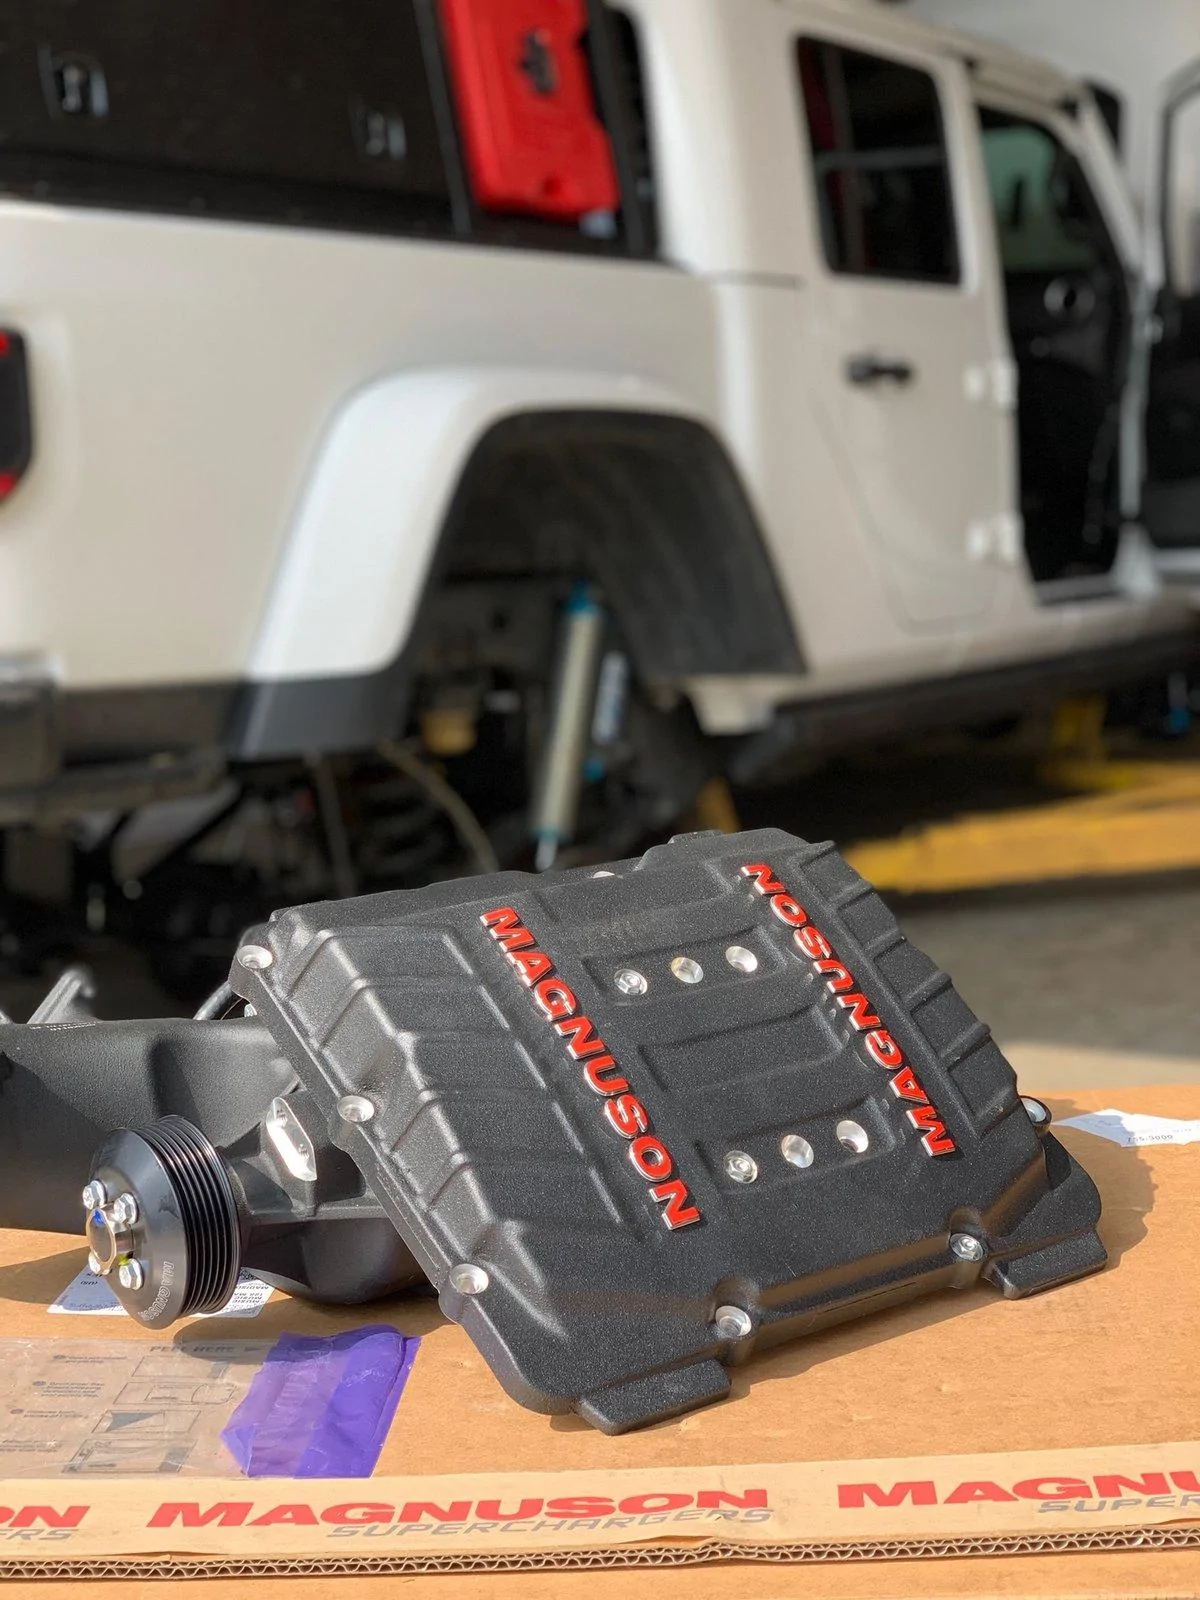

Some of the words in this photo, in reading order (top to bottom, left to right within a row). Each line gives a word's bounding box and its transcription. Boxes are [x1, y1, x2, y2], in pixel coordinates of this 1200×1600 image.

[741, 862, 957, 1158] MAGNUSON
[479, 906, 701, 1231] MAGNUSON
[0, 1506, 91, 1527] N
[146, 1489, 768, 1527] MAGNUSON
[327, 1508, 775, 1538] SUPERCHARGERS
